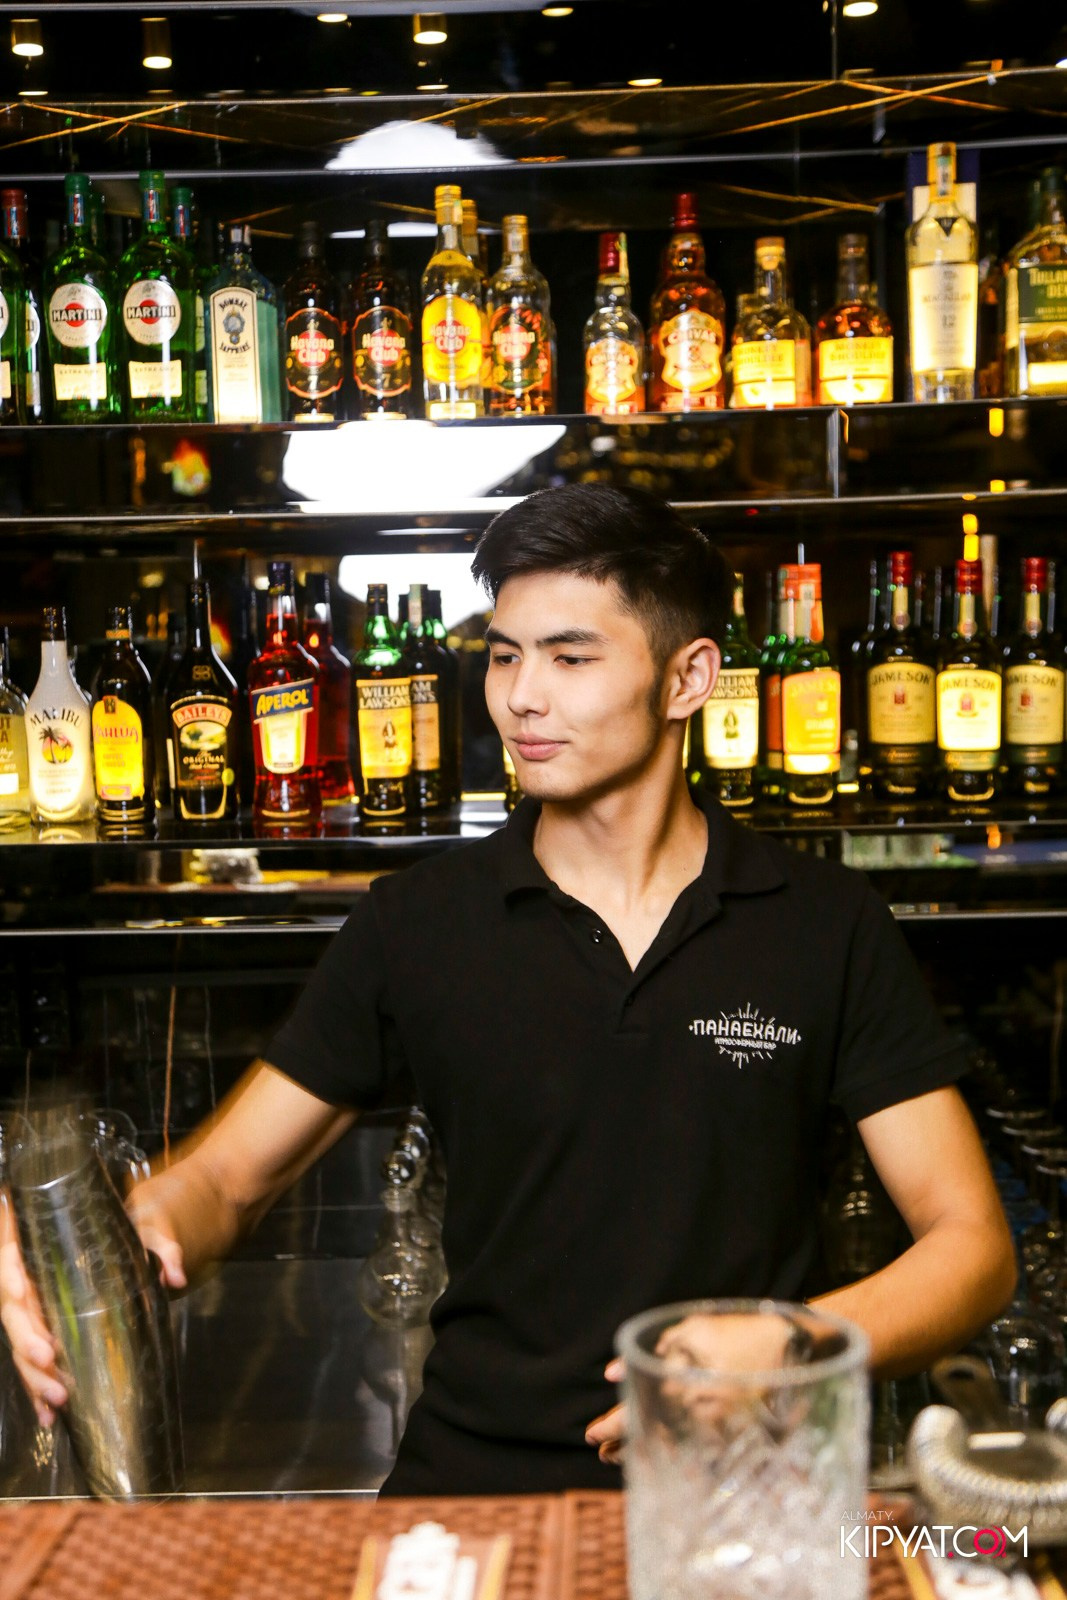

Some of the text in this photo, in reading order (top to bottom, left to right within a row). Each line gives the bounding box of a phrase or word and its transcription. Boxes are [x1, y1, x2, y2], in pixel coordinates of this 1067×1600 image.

[1027, 268, 1067, 287] TULLA
[127, 305, 176, 320] MARTINI
[219, 298, 249, 312] BOMBAY
[52, 308, 102, 322] MARTINI
[290, 335, 335, 351] Havana
[361, 333, 406, 349] Havana
[667, 328, 717, 344] CIVAS
[298, 348, 326, 363] Club
[371, 346, 399, 363] Club
[717, 675, 756, 688] ILLIAM
[872, 671, 931, 686] JAMESON
[941, 677, 997, 692] JAMESON
[361, 685, 410, 698] WILLIAM
[256, 689, 309, 716] APEROL
[30, 707, 82, 727] MALIBU
[175, 706, 228, 723] BAILEYS
